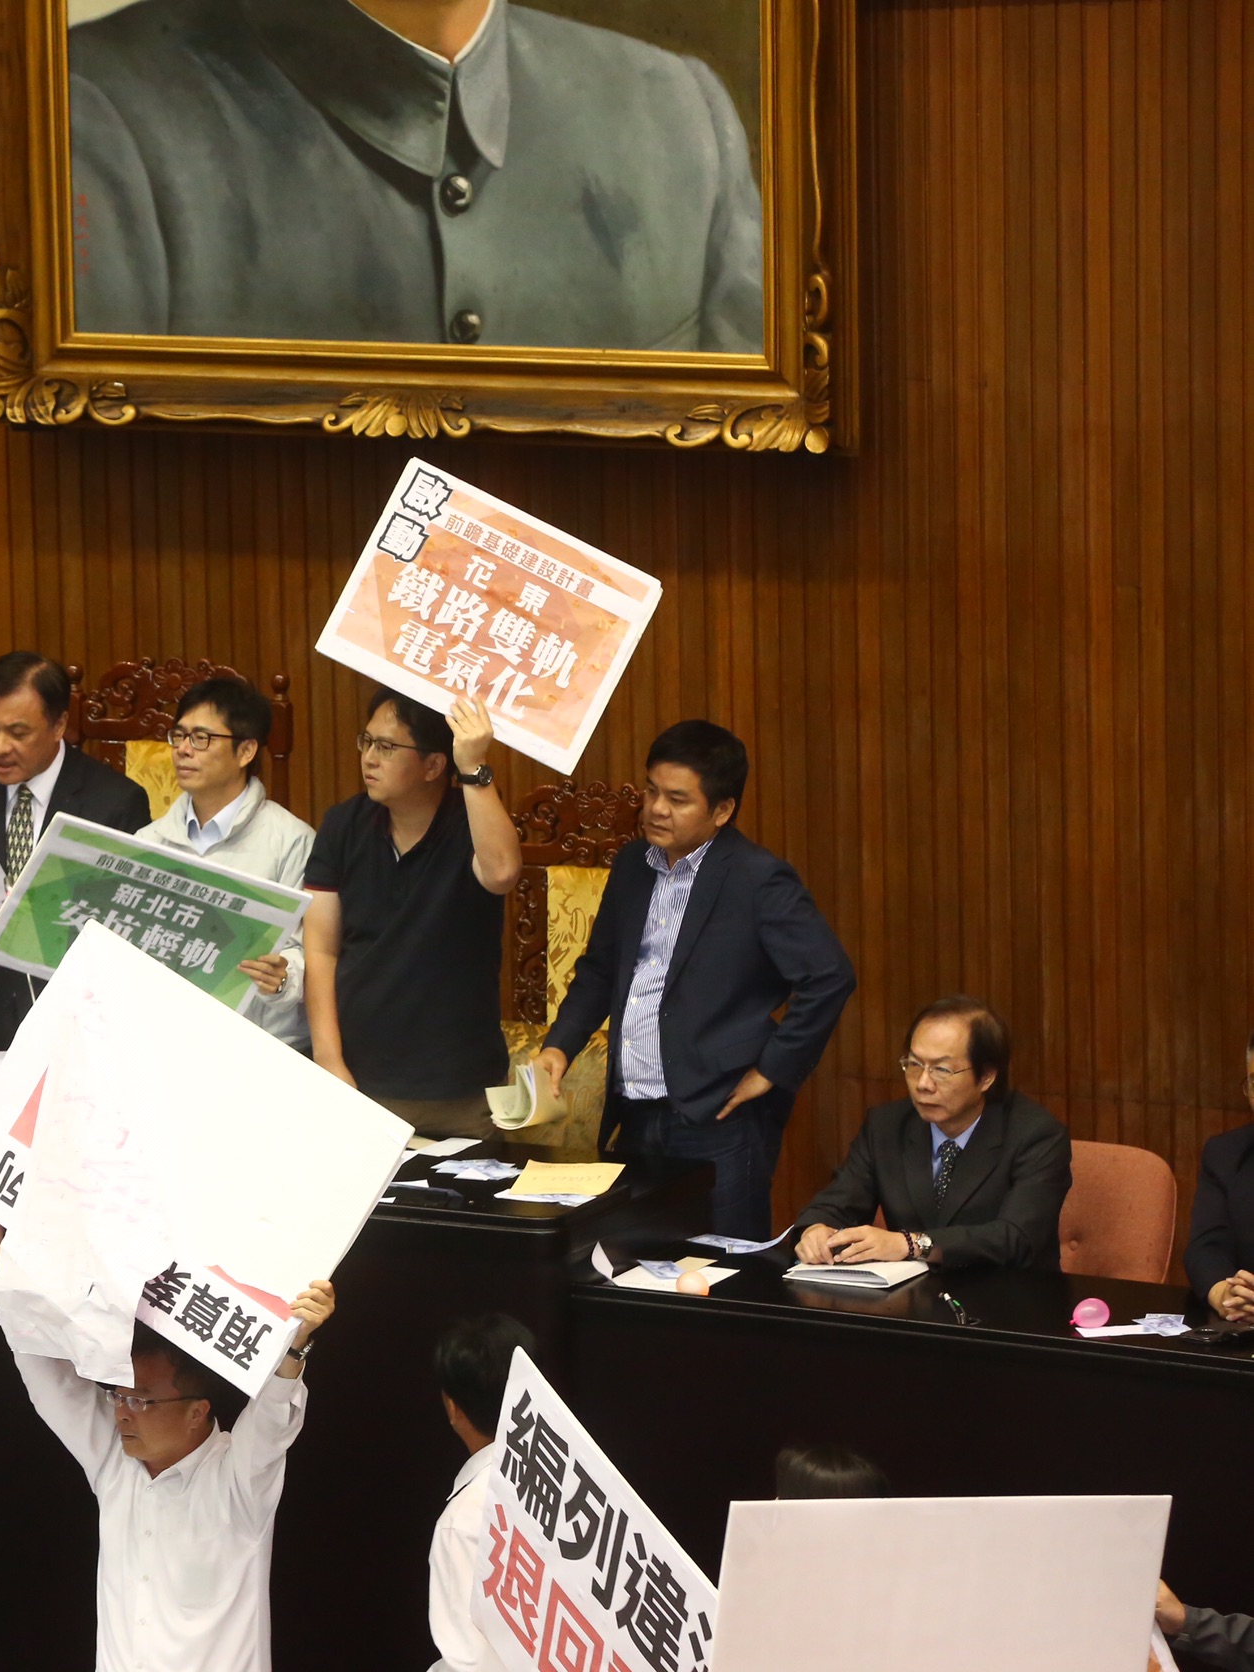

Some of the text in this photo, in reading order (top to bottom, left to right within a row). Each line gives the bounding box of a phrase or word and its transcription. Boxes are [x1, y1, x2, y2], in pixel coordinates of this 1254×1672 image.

[377, 467, 453, 563] 啟動
[444, 513, 596, 600] 前瞻基礎建設計畫
[387, 564, 578, 689] 鐵路雙軌
[392, 619, 536, 720] 電氣化
[95, 854, 247, 913] 前瞻基礎建設計畫
[110, 882, 205, 930] 新北市
[500, 1389, 713, 1672] 編列違
[482, 1504, 632, 1672] 退回
